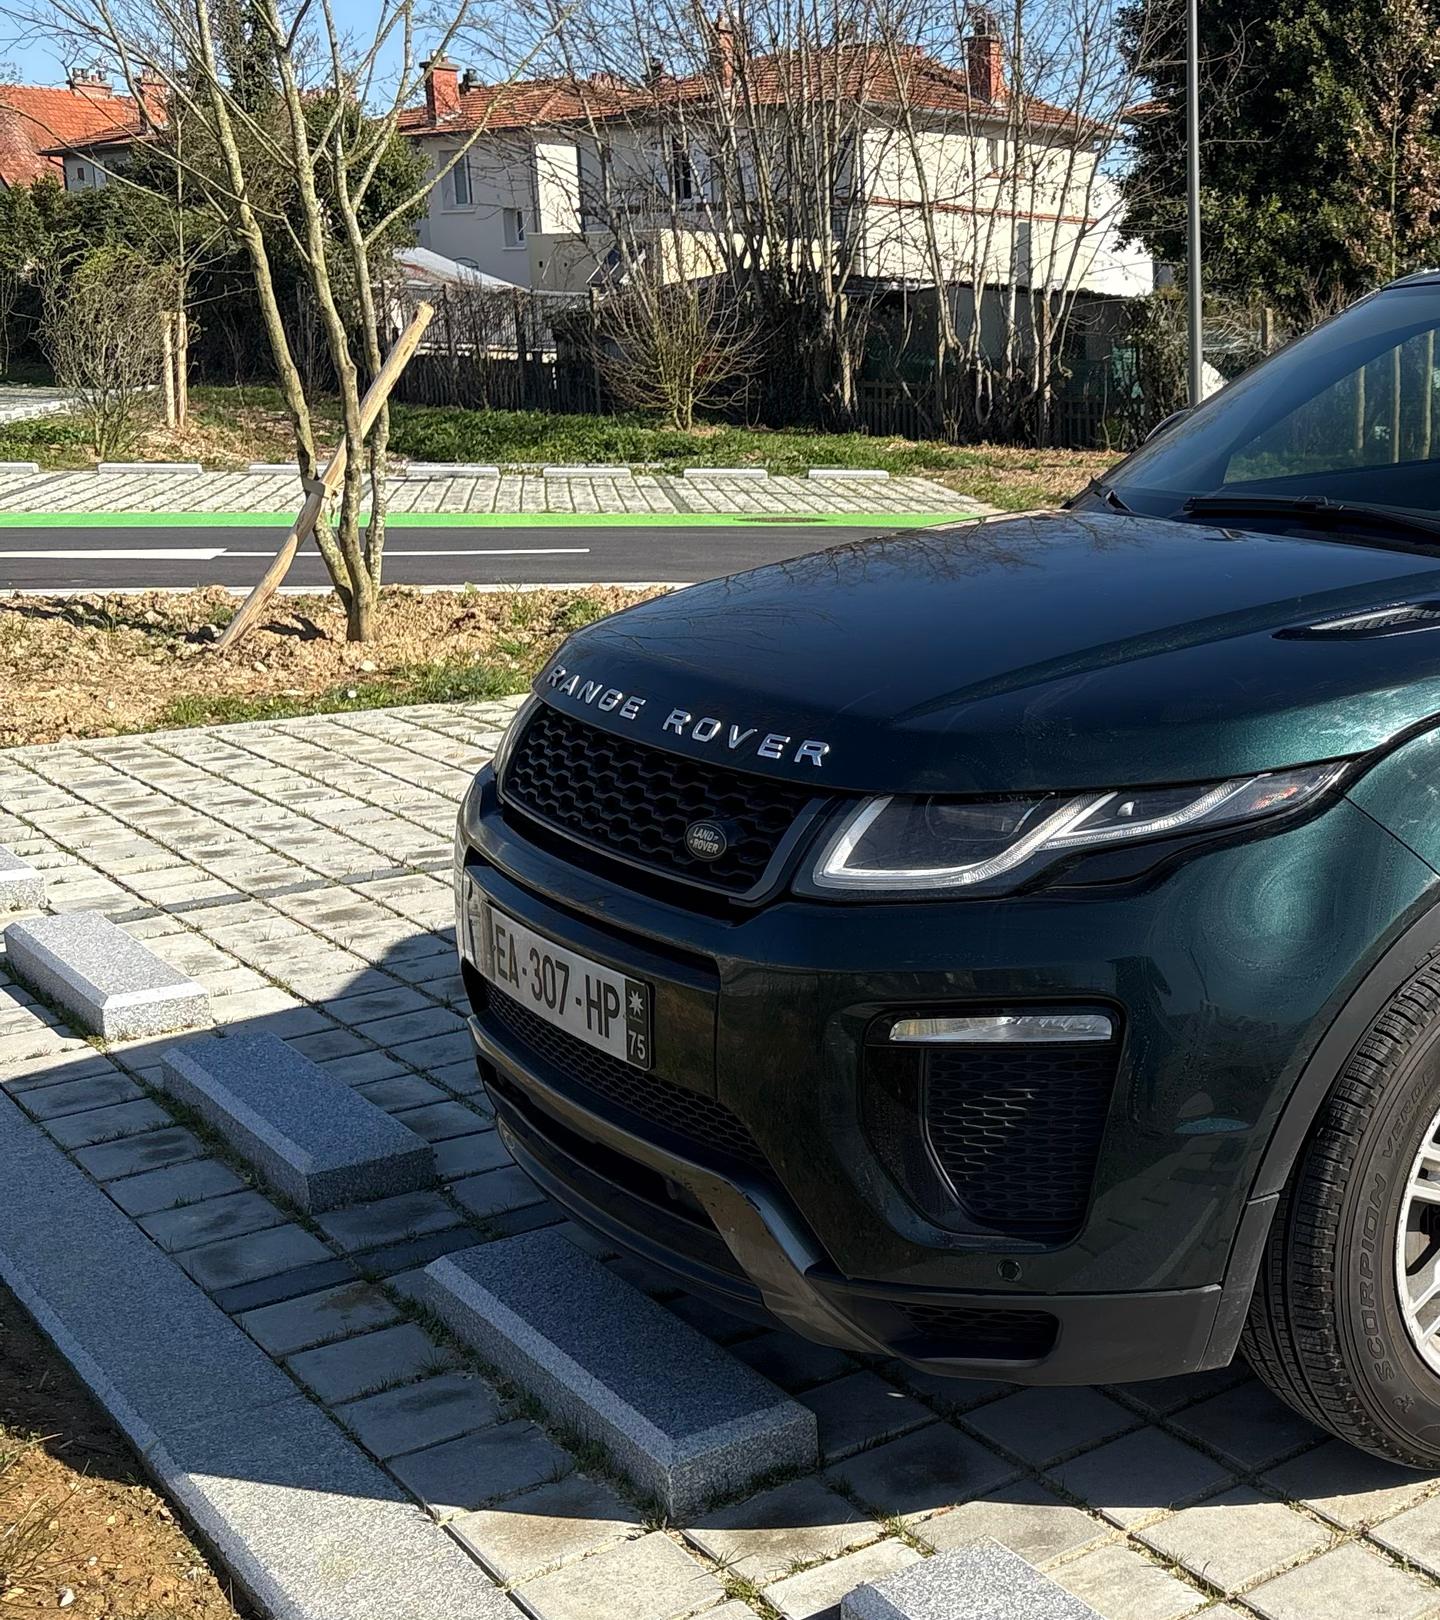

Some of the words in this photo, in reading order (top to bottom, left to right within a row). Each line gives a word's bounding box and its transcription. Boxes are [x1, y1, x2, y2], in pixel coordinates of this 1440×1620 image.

[546, 664, 646, 721] RANGE
[662, 707, 831, 767] ROVER
[693, 827, 714, 840] LAND
[693, 839, 719, 853] ROVER
[628, 1030, 646, 1060] 75
[1360, 1173, 1395, 1382] SCORPION
